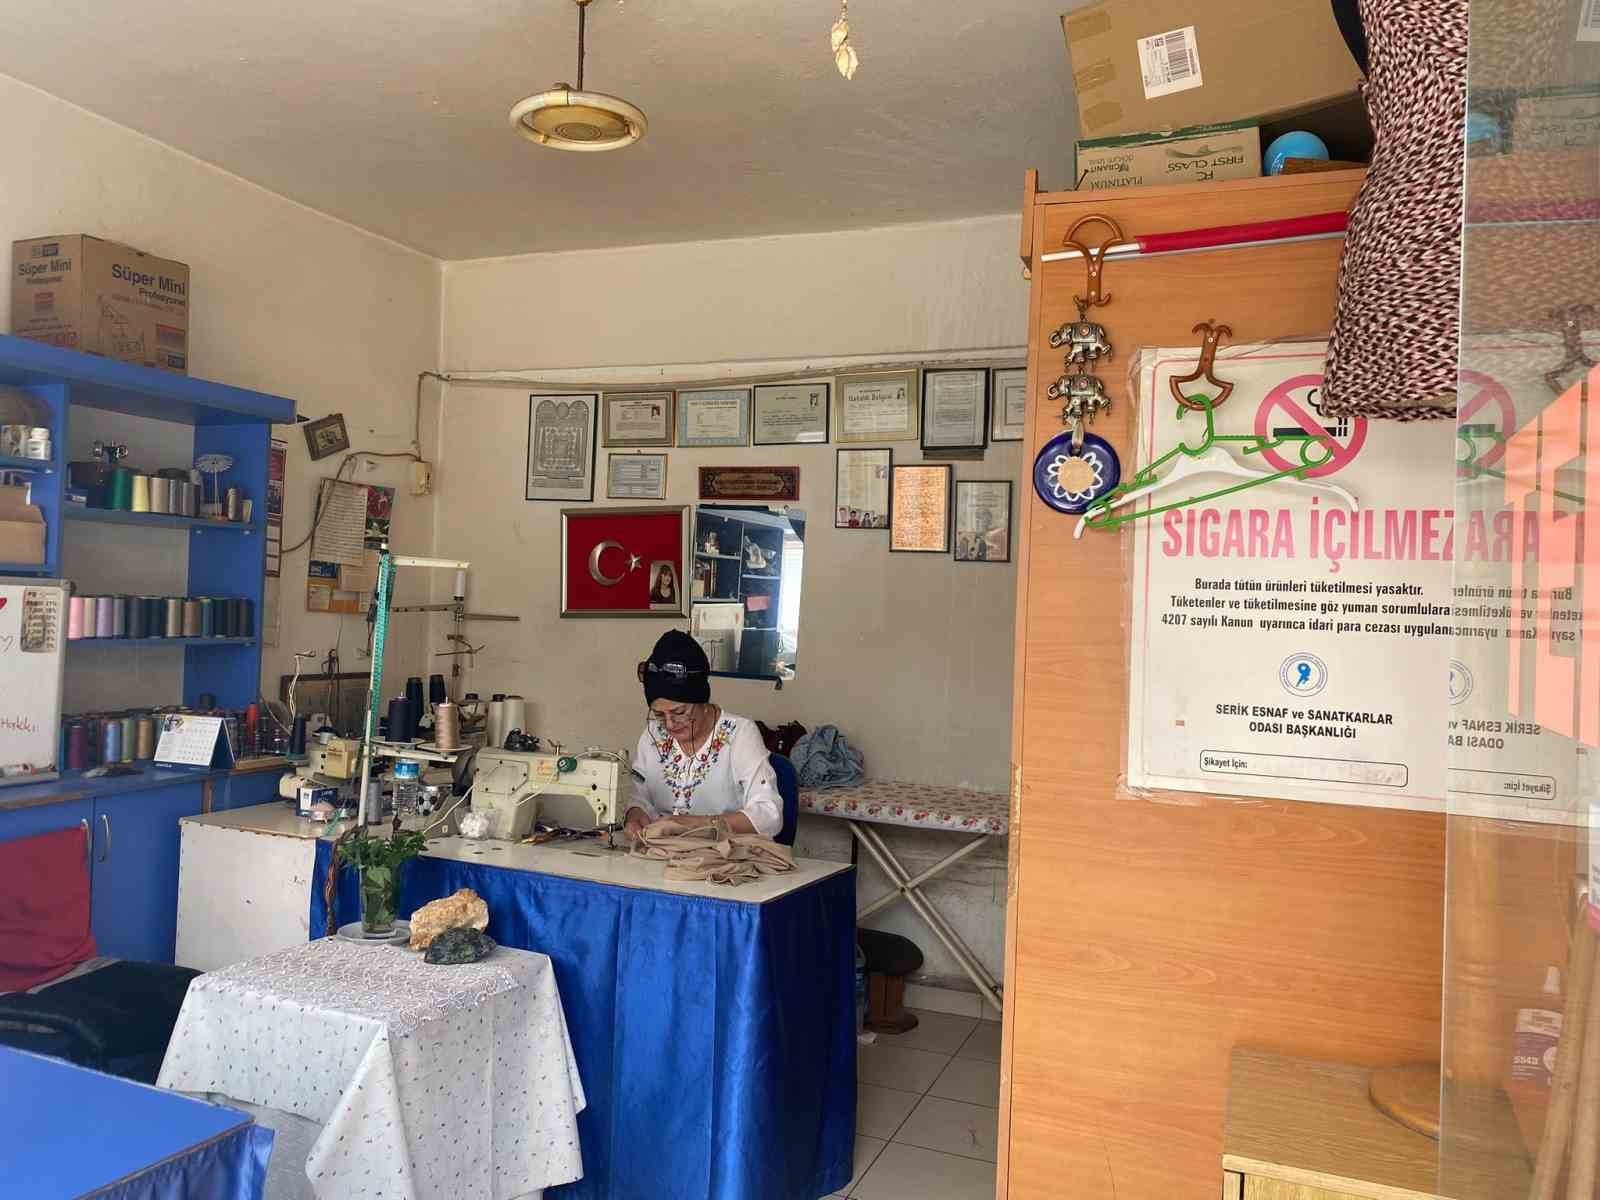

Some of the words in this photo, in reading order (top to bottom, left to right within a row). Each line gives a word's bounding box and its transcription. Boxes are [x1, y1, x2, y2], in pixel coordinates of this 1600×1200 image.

[1167, 158, 1209, 173] CLASS
[1210, 156, 1244, 168] FIRST
[17, 262, 47, 277] Süper
[50, 258, 72, 273] Mini
[111, 263, 155, 286] Süper
[159, 275, 185, 297] Mini
[1162, 496, 1295, 558] SİGARA
[1195, 577, 1231, 591] Burada
[1234, 579, 1262, 591] tütün
[1265, 579, 1307, 593] ürünleri
[1310, 581, 1373, 595] tüketilmesi
[1376, 583, 1424, 598] yasaktır.
[1171, 595, 1226, 609] Tüketenler
[1228, 599, 1240, 609] ve
[1244, 598, 1318, 613] tüketilmesine
[1320, 600, 1339, 615] göz
[1342, 603, 1378, 616] yuman
[1382, 602, 1450, 616] sorumlulara
[1161, 613, 1187, 625] 4207
[1190, 614, 1218, 630] sayılı
[1221, 615, 1253, 628] Kanun
[1259, 619, 1306, 632] uyarınca
[1308, 617, 1334, 631] idari
[1337, 621, 1361, 634] para
[1364, 623, 1400, 634] cezası
[1216, 702, 1249, 716] SERİK
[1252, 706, 1288, 719] ESNAF
[1292, 711, 1304, 720] ve
[1307, 709, 1393, 725] SANATKARLAR
[1249, 721, 1283, 734] ODASI
[1286, 722, 1356, 738] BAŞKANLIĞI
[1204, 756, 1230, 769] Şikayet
